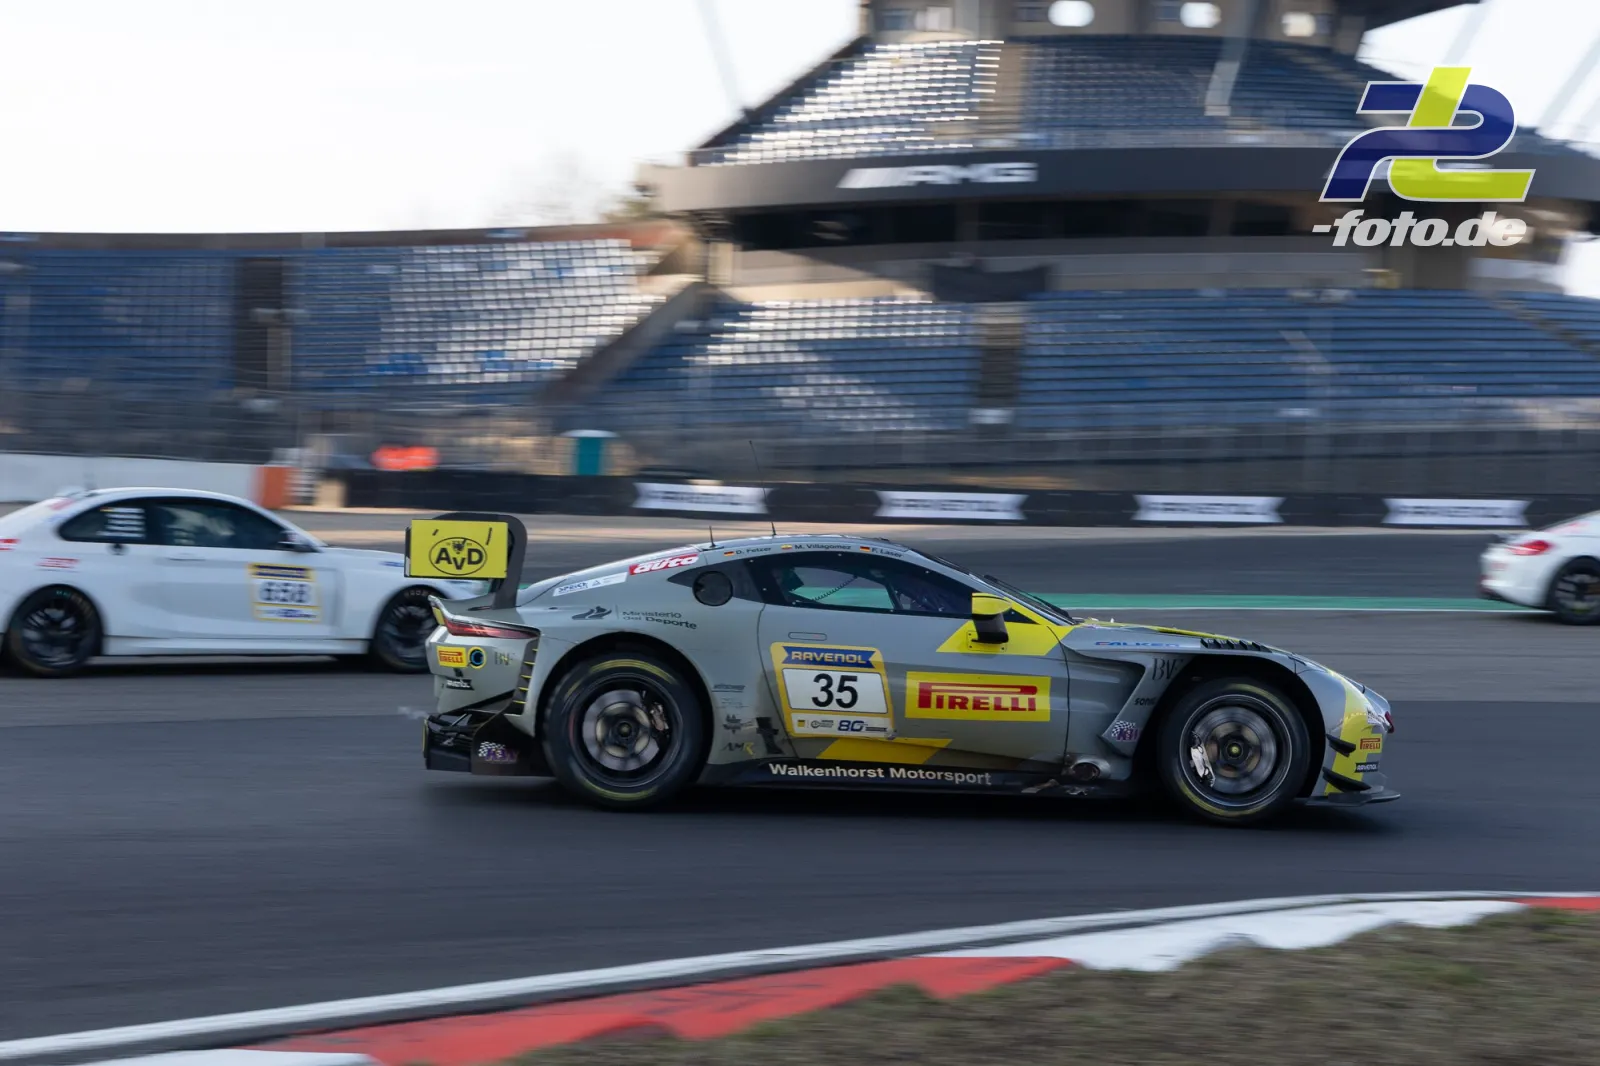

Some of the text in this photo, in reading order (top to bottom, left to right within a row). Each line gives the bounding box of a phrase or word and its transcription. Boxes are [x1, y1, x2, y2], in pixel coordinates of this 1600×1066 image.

[633, 555, 699, 574] auto
[622, 611, 682, 619] Ministerio
[645, 616, 698, 630] Deporte
[438, 650, 464, 664] PIRELLI
[791, 651, 867, 664] RAVENOL
[811, 673, 858, 709] 35
[918, 682, 1038, 712] PIRELLI
[1360, 738, 1381, 750] PIRELLI
[769, 763, 992, 786] Walkenhorst Motorsport
